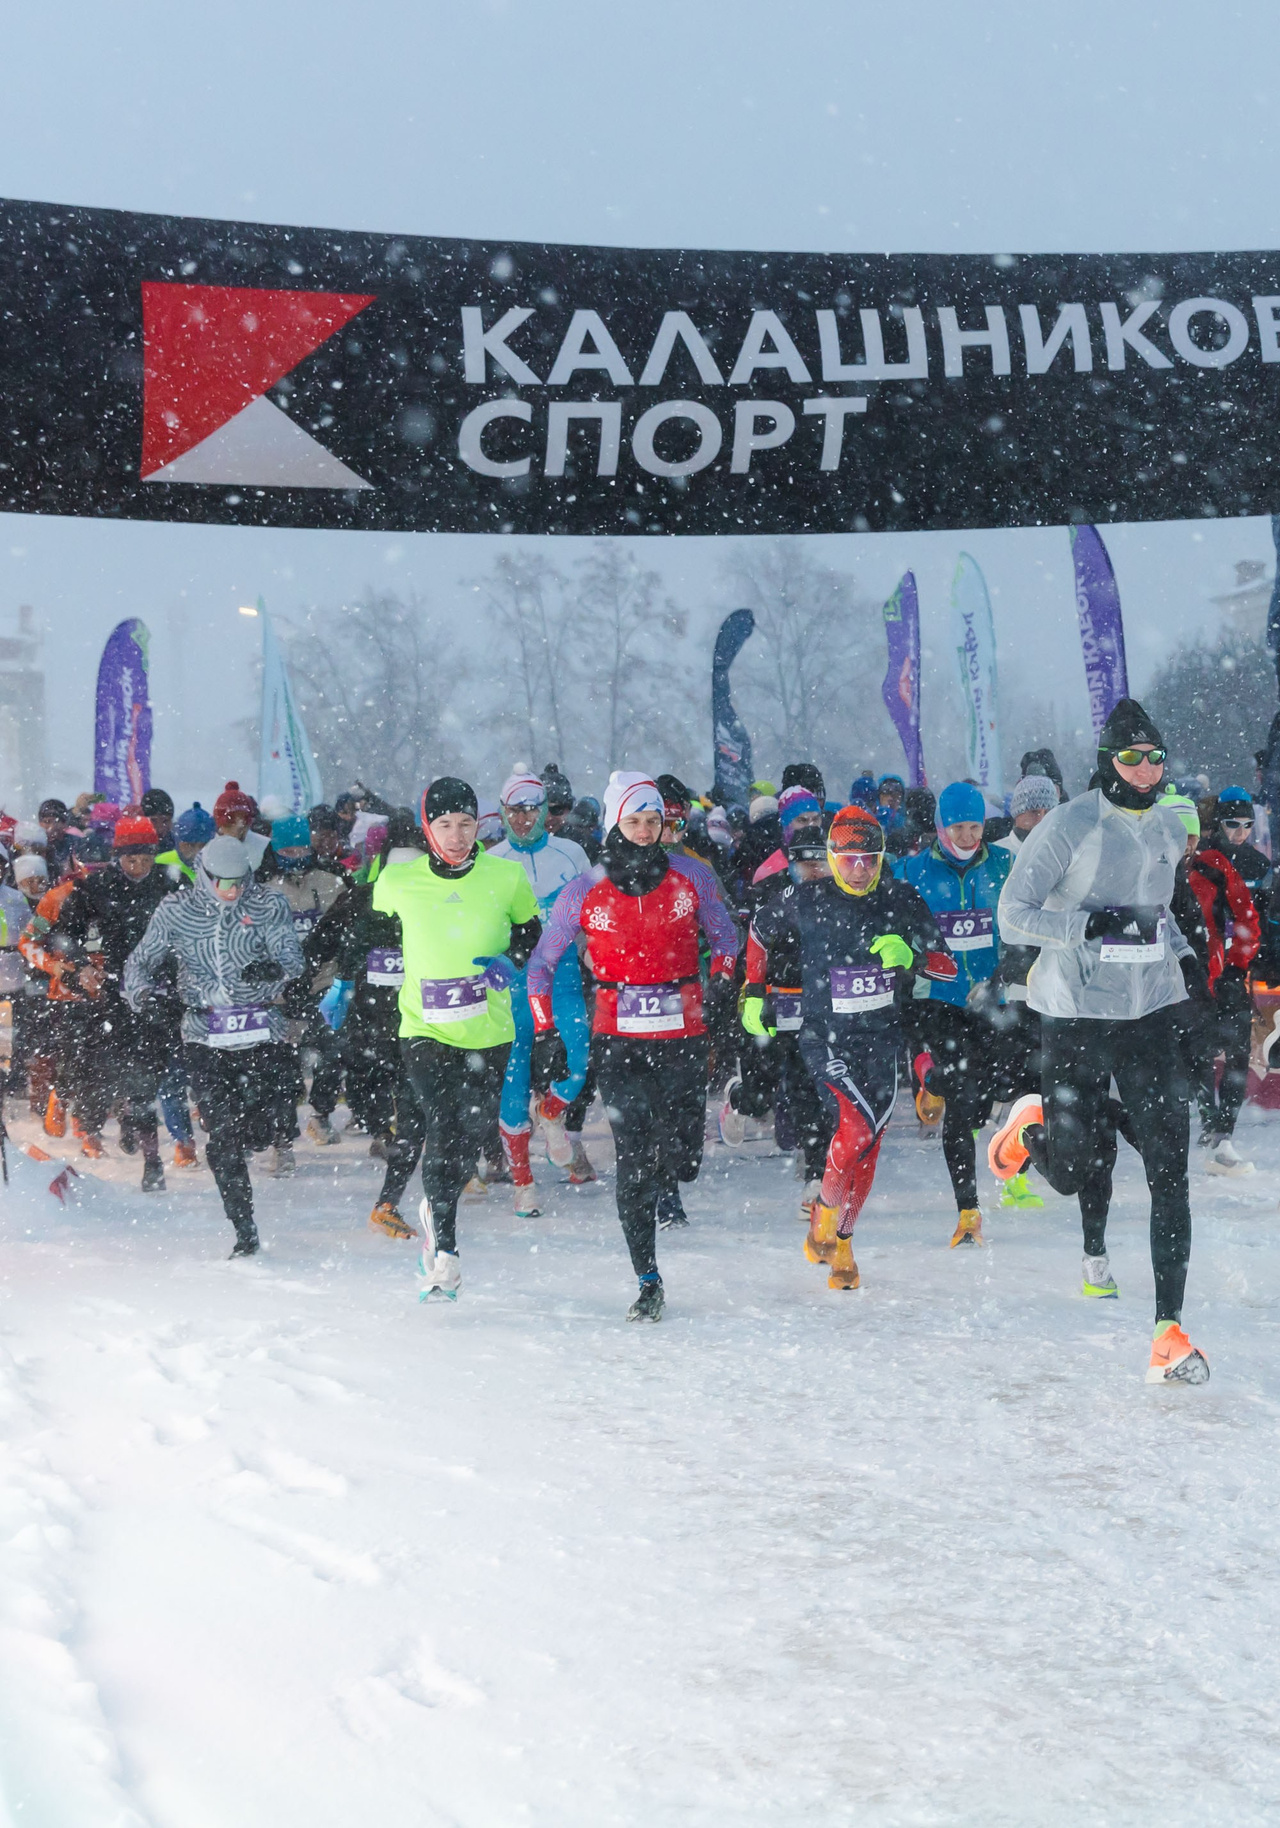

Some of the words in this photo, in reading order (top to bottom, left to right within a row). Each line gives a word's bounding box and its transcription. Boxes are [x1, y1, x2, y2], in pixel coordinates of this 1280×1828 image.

[457, 396, 867, 479] СПОРТ
[952, 920, 975, 936] 69
[384, 956, 404, 972] 99
[852, 976, 876, 994] 83
[446, 987, 463, 1006] 2
[639, 997, 661, 1015] 12
[226, 1014, 248, 1031] 87
